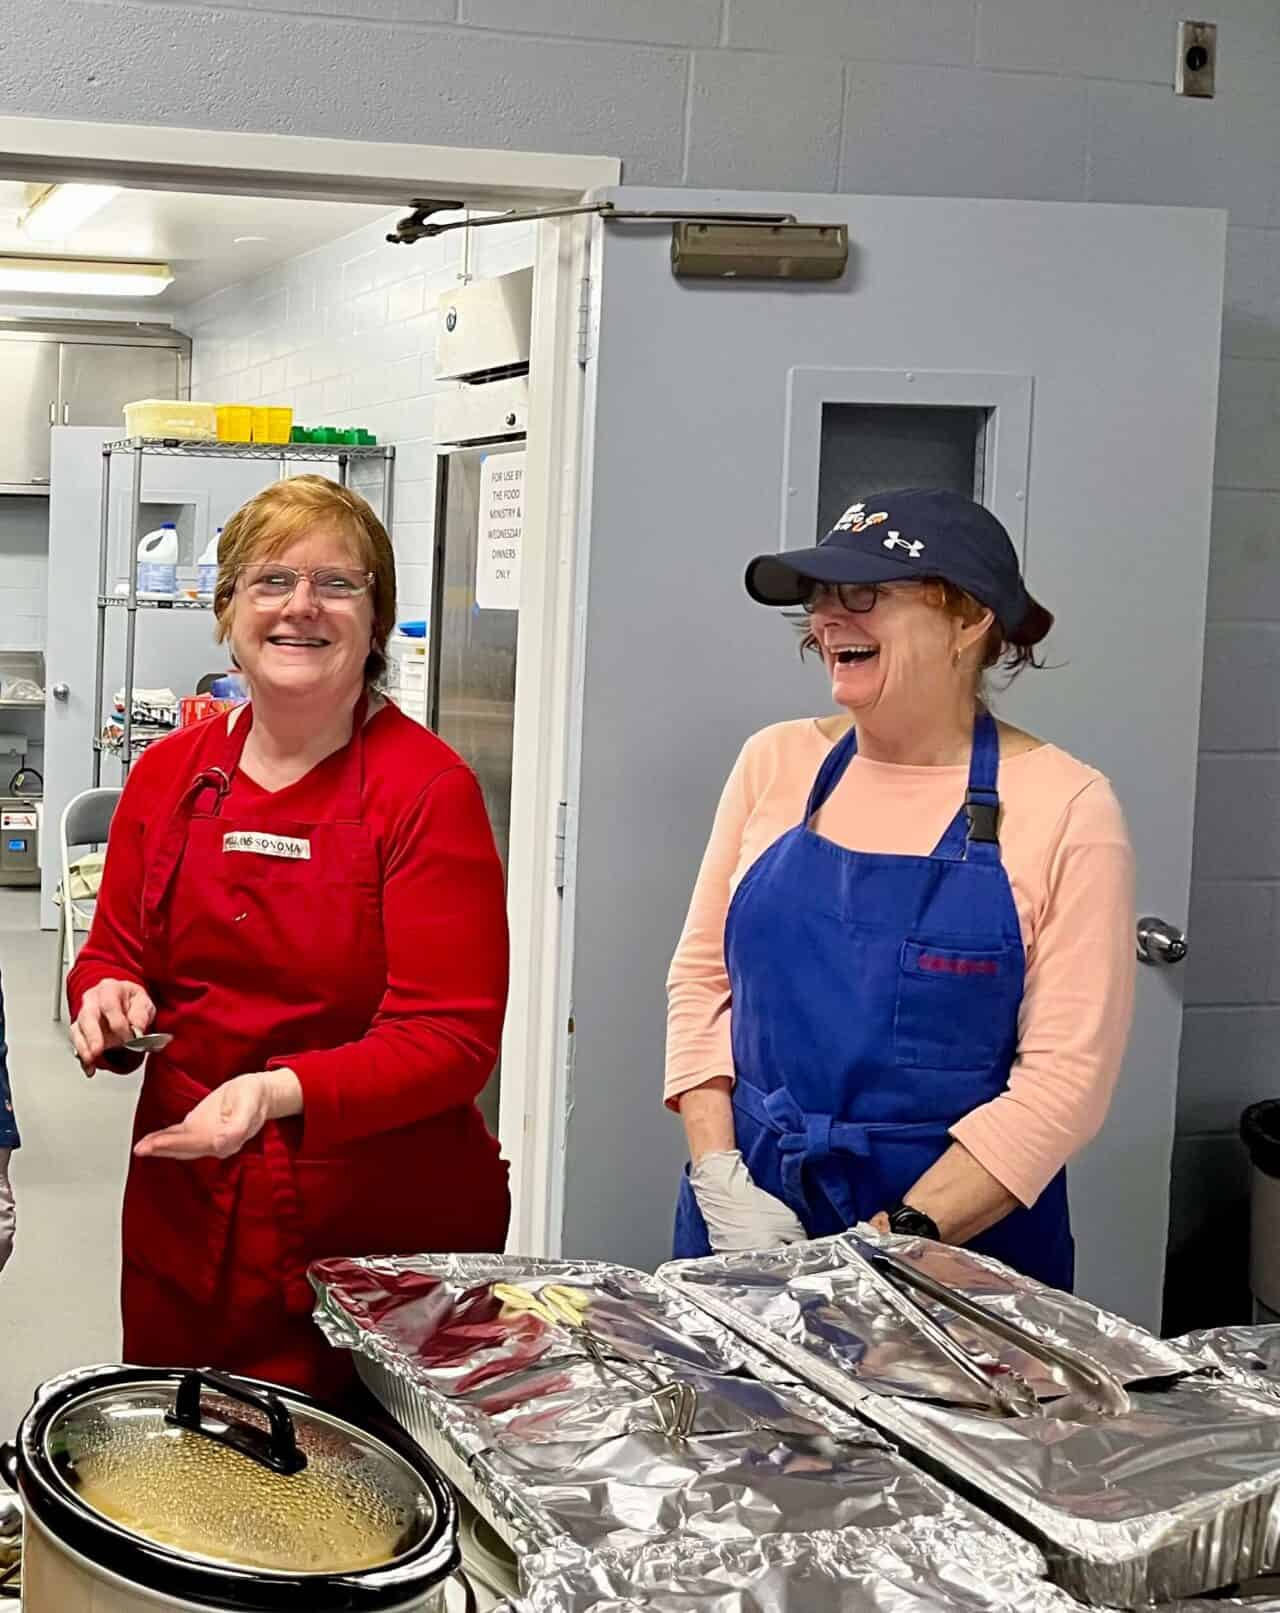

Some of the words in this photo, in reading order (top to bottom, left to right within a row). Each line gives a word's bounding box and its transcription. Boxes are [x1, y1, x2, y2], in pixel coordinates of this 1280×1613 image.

[491, 471, 502, 483] FOR
[504, 470, 514, 481] USE
[493, 490, 503, 501] THE
[504, 489, 520, 500] FOOD
[490, 508, 516, 519] MINISTRY
[488, 527, 522, 539] WEDNESDAY
[491, 548, 516, 560] DINNERS
[495, 569, 511, 580] ONLY
